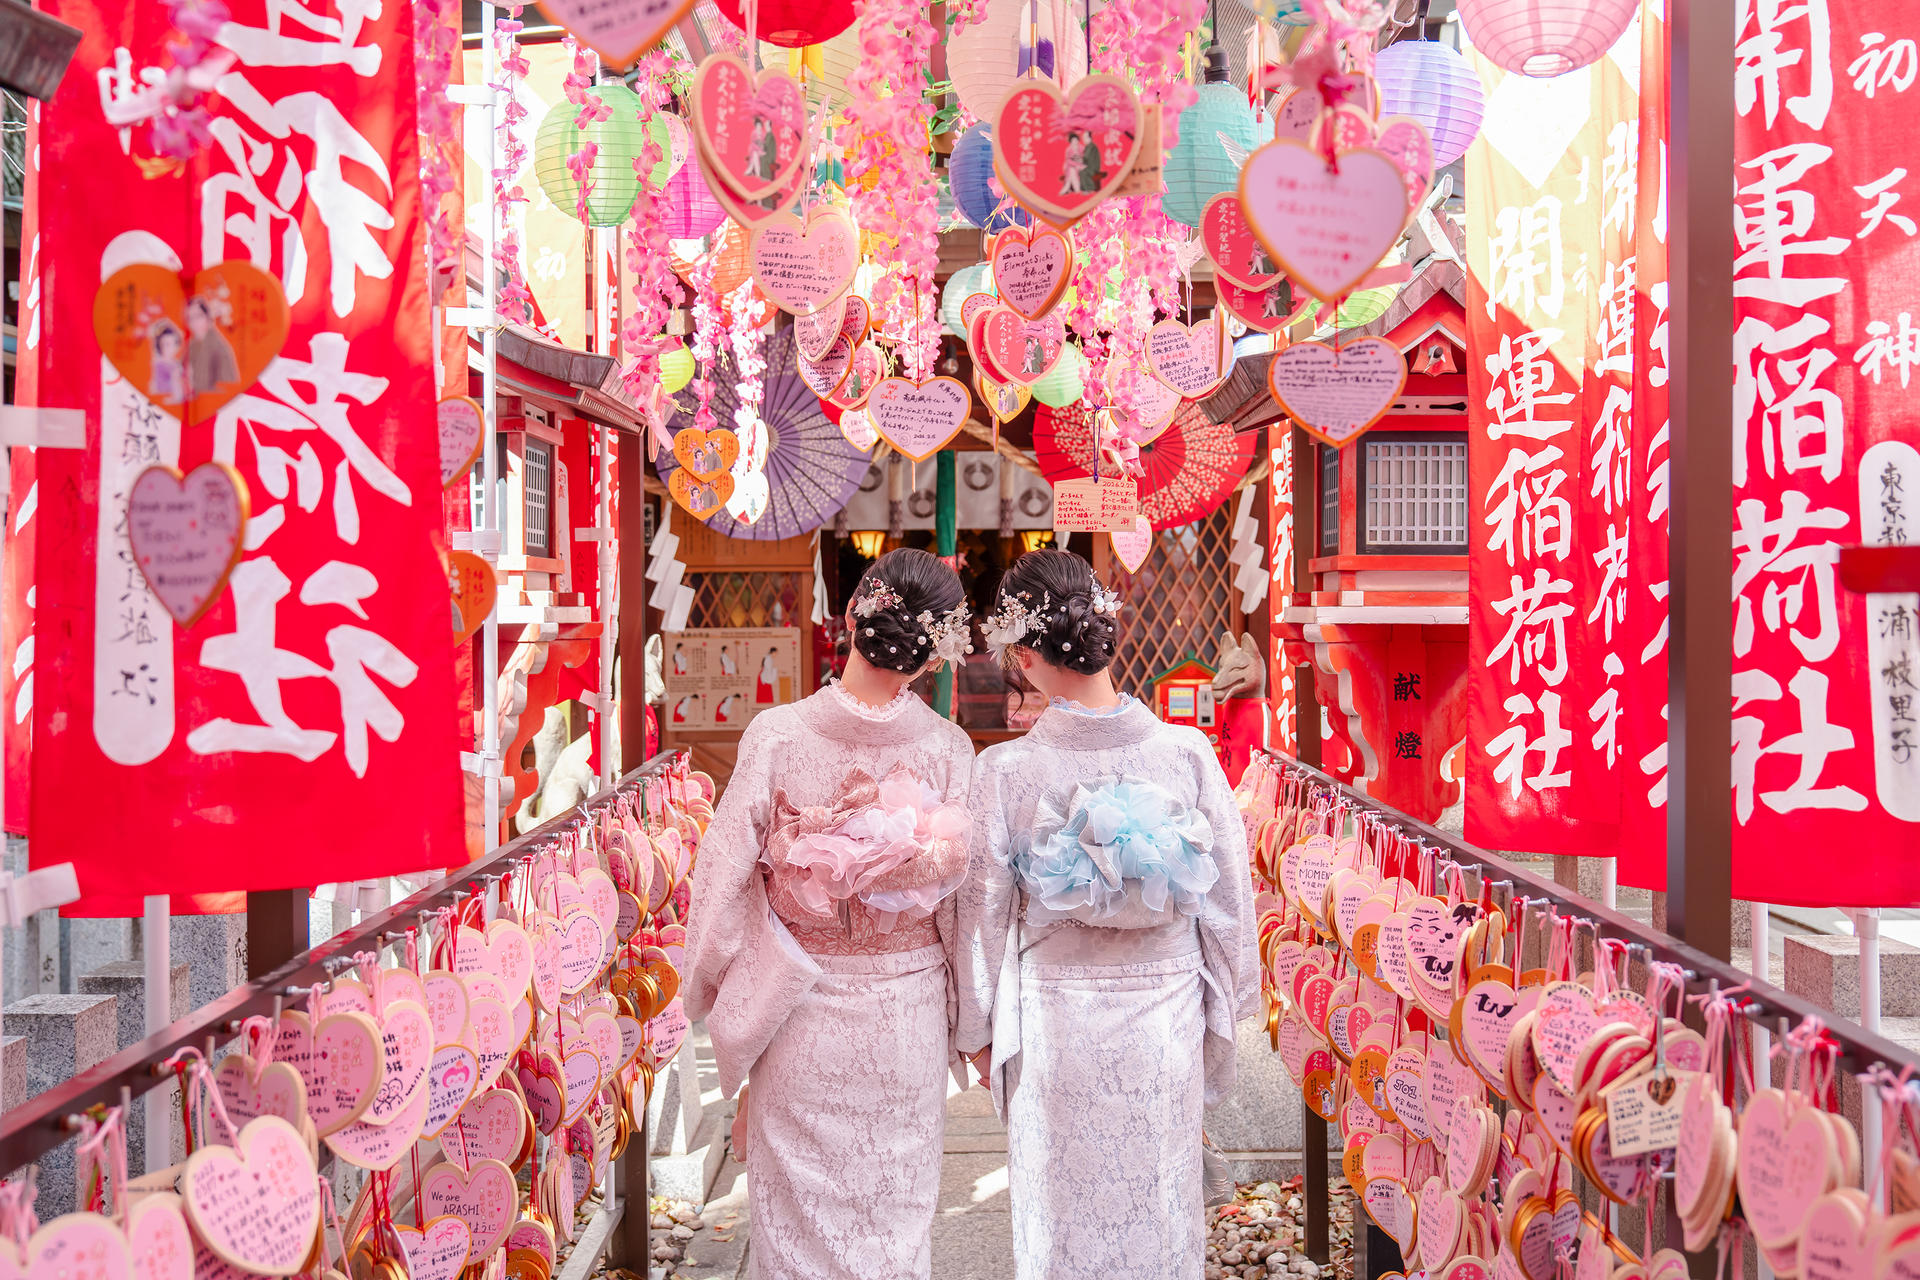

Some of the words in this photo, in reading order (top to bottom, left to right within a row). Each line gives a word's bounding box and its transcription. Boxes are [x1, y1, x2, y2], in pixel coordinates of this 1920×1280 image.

[1217, 201, 1232, 253] 恋人の聖地
[1485, 194, 1575, 800] 開運稲荷社
[1393, 671, 1423, 761] 献燈
[1299, 868, 1333, 881] MOMEN
[431, 1191, 444, 1202] We
[445, 1194, 461, 1203] are
[442, 1203, 480, 1216] ARASHI
